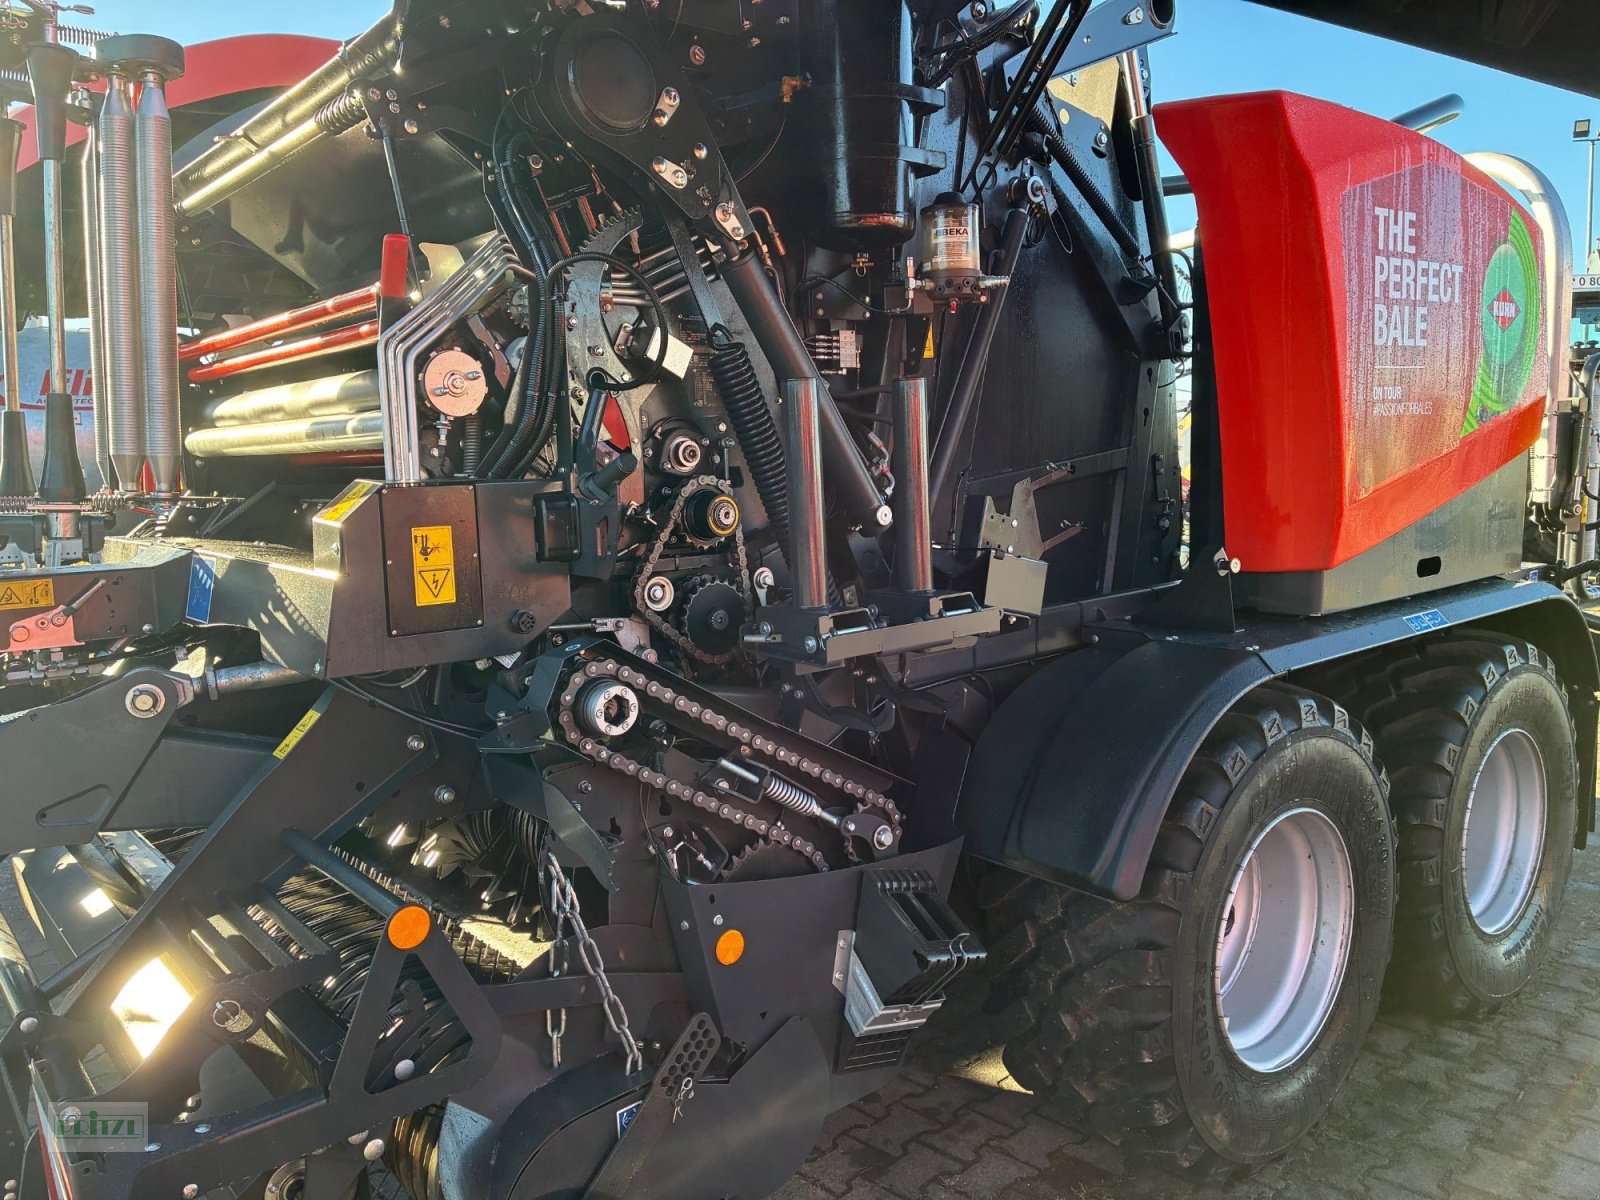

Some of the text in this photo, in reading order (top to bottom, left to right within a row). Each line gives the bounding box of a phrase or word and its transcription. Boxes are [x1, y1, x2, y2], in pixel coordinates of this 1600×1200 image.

[943, 228, 969, 236] BEKA
[1374, 206, 1417, 254] THE
[1374, 255, 1464, 304] PERFECT
[1493, 301, 1516, 318] KUHN
[1374, 303, 1428, 347] BALE
[1373, 386, 1402, 400] ON TOUR
[1373, 401, 1433, 417] #PASSIONFORBALES
